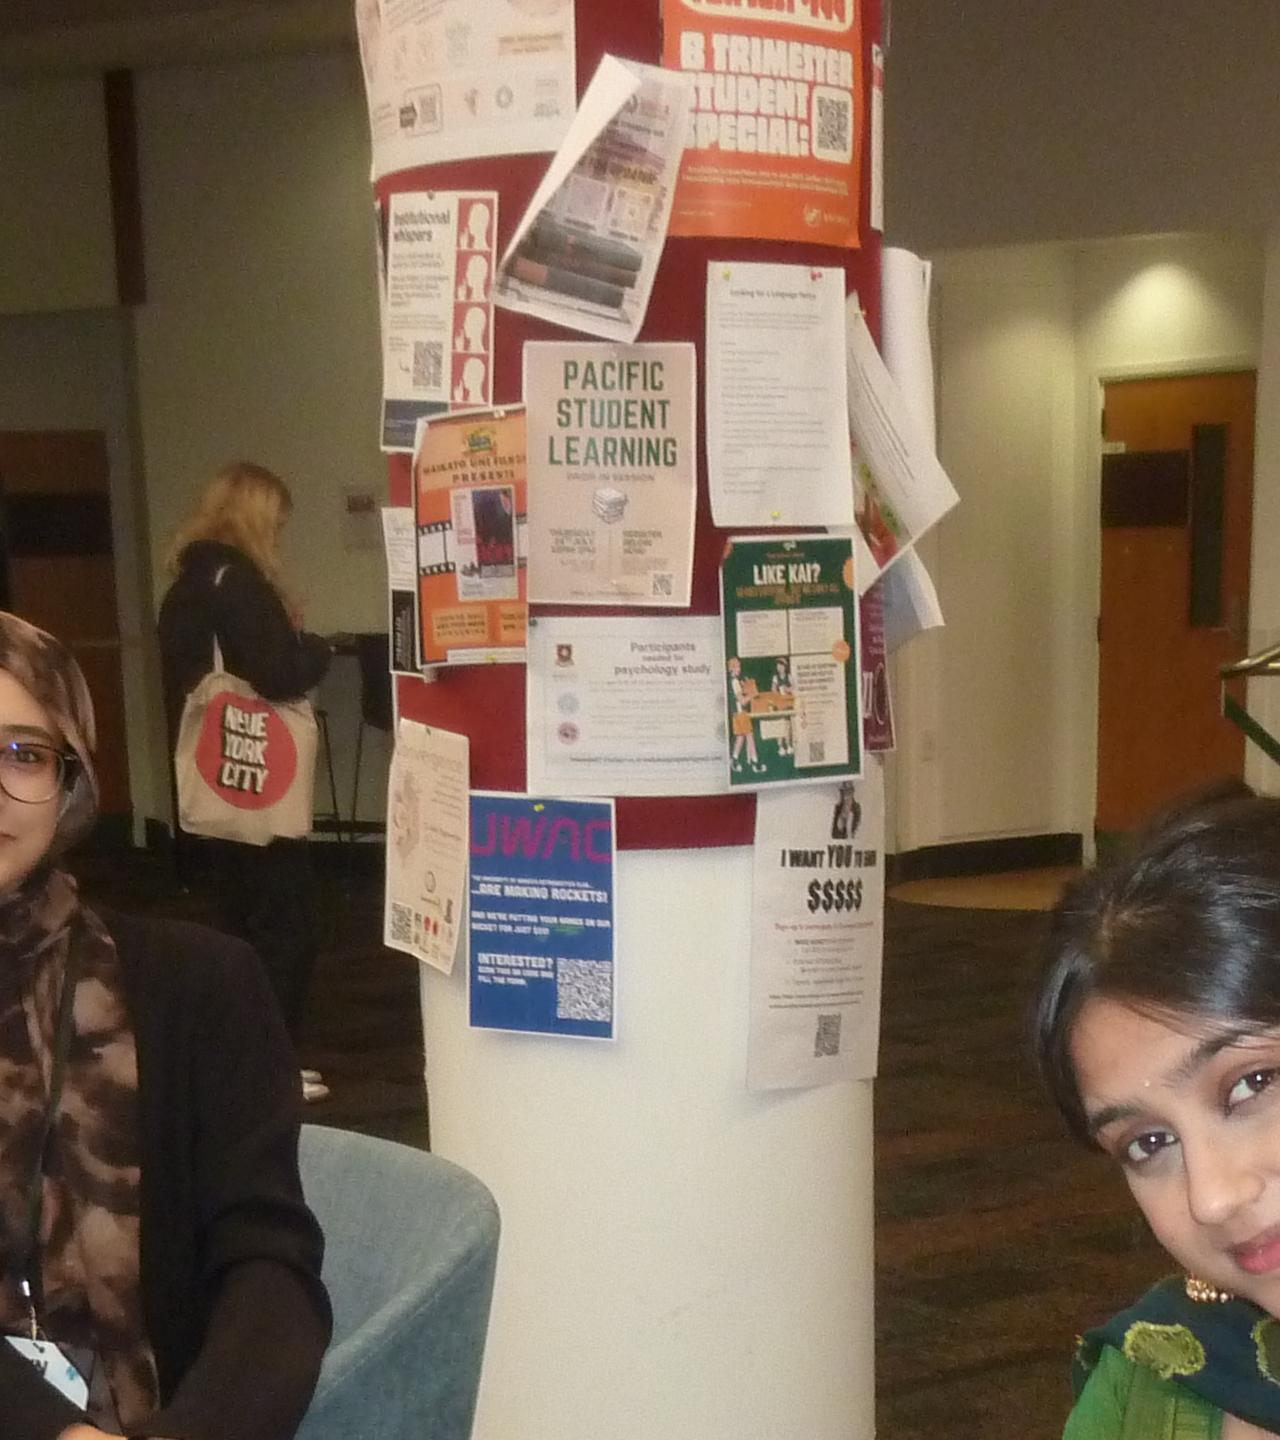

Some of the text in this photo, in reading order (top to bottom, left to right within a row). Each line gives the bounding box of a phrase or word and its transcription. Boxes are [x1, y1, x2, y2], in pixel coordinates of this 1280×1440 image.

[563, 361, 664, 391] PACIFIC
[557, 399, 670, 429] STUDENT
[549, 436, 678, 467] LEARNING
[753, 563, 821, 585] LIKE KAI?
[631, 642, 696, 652] Participants
[615, 664, 711, 676] psychology study
[223, 732, 268, 766] YORK
[218, 762, 269, 794] CITY
[789, 850, 825, 867] WANT
[827, 844, 853, 868] YOU
[504, 885, 548, 900] MAKING
[551, 887, 608, 904] ROCKETS!
[807, 878, 863, 914] $$$$$
[478, 952, 553, 969] INTERESTED?
